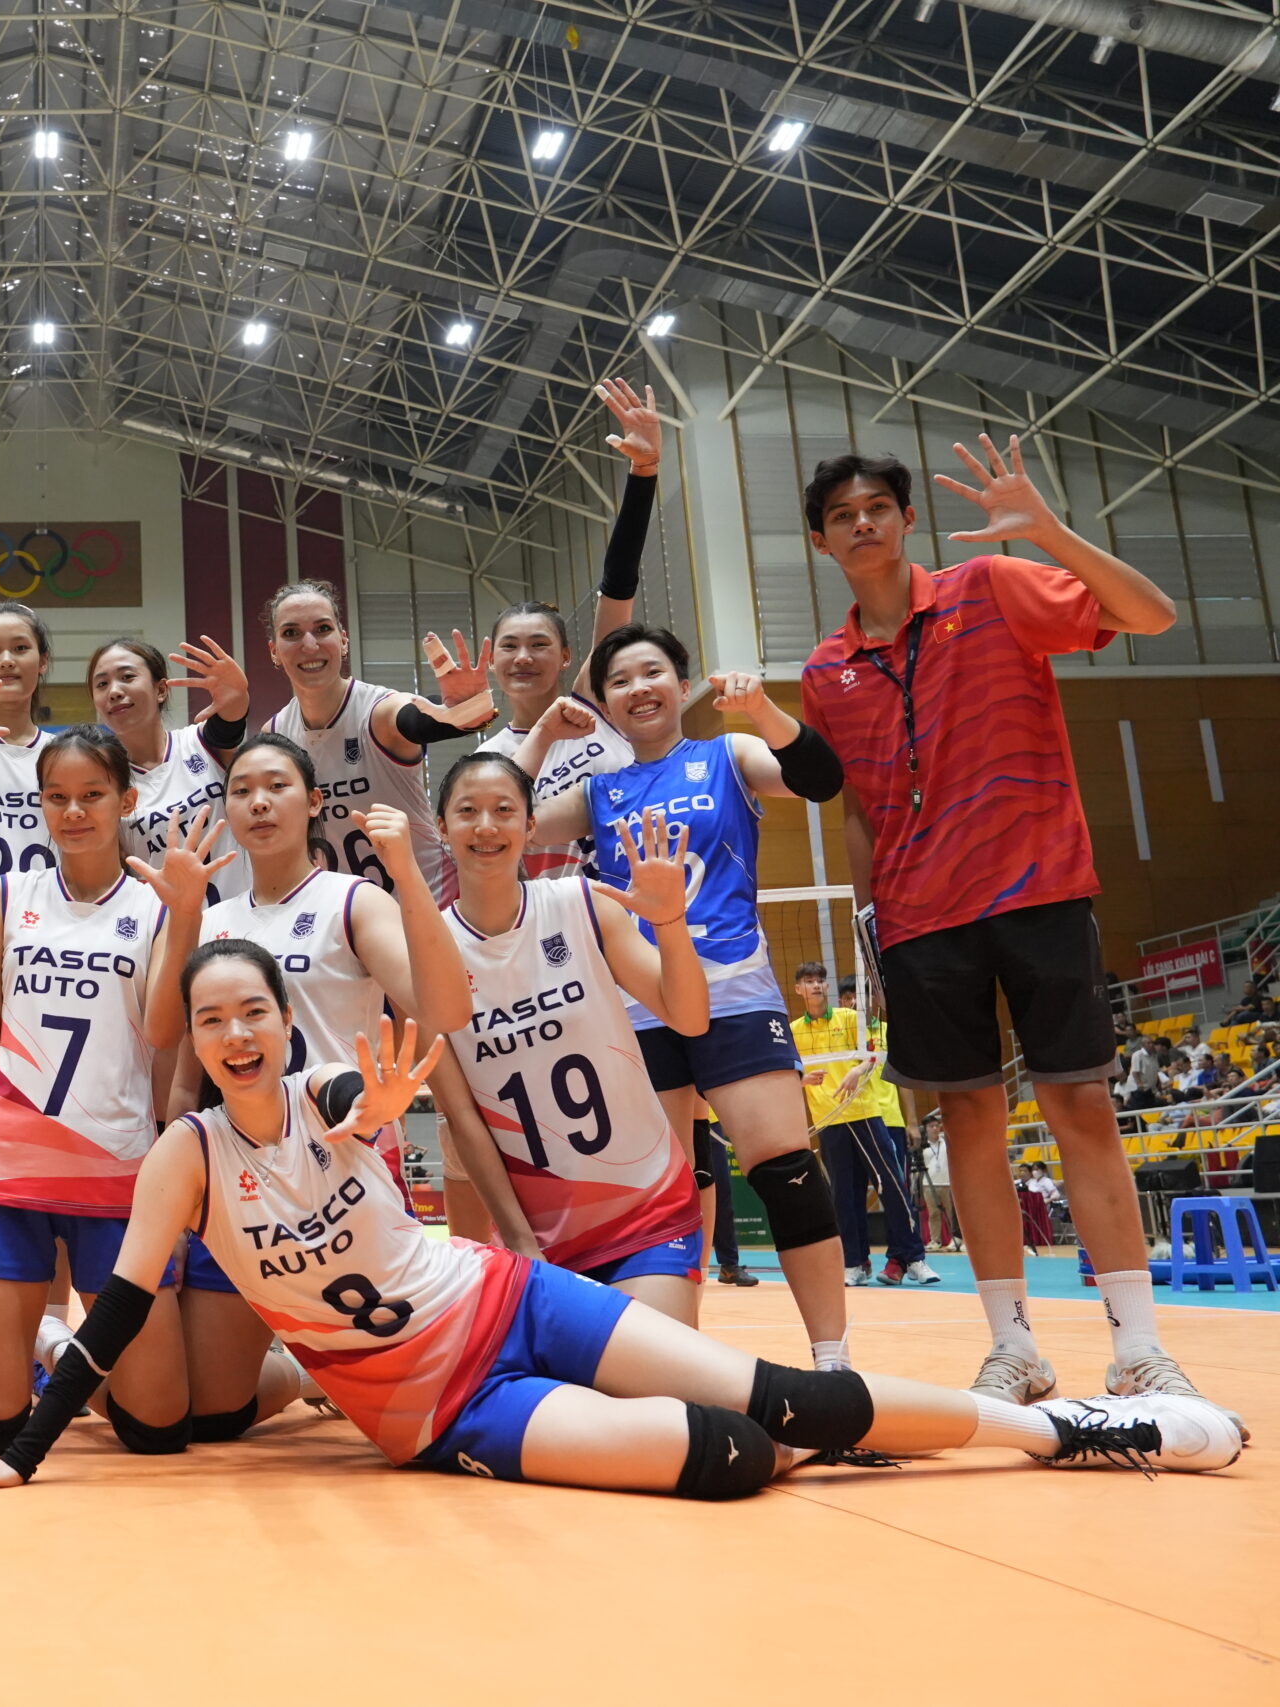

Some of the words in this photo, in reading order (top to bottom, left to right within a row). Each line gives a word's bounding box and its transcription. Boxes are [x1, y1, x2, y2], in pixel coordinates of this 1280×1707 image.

[319, 777, 370, 800] SCO
[535, 742, 605, 794] ASCO
[129, 782, 225, 836] TASCO
[321, 804, 349, 822] TO
[13, 945, 136, 979] TASCO
[13, 974, 100, 999] AUTO
[471, 979, 585, 1034] TASCO
[41, 1013, 91, 1117] 7
[476, 1019, 563, 1063] AUTO
[497, 1053, 612, 1169] 19
[243, 1175, 366, 1251] TASCO
[259, 1229, 354, 1280] AUTO
[322, 1273, 414, 1338] 8
[457, 1451, 494, 1477] 8
